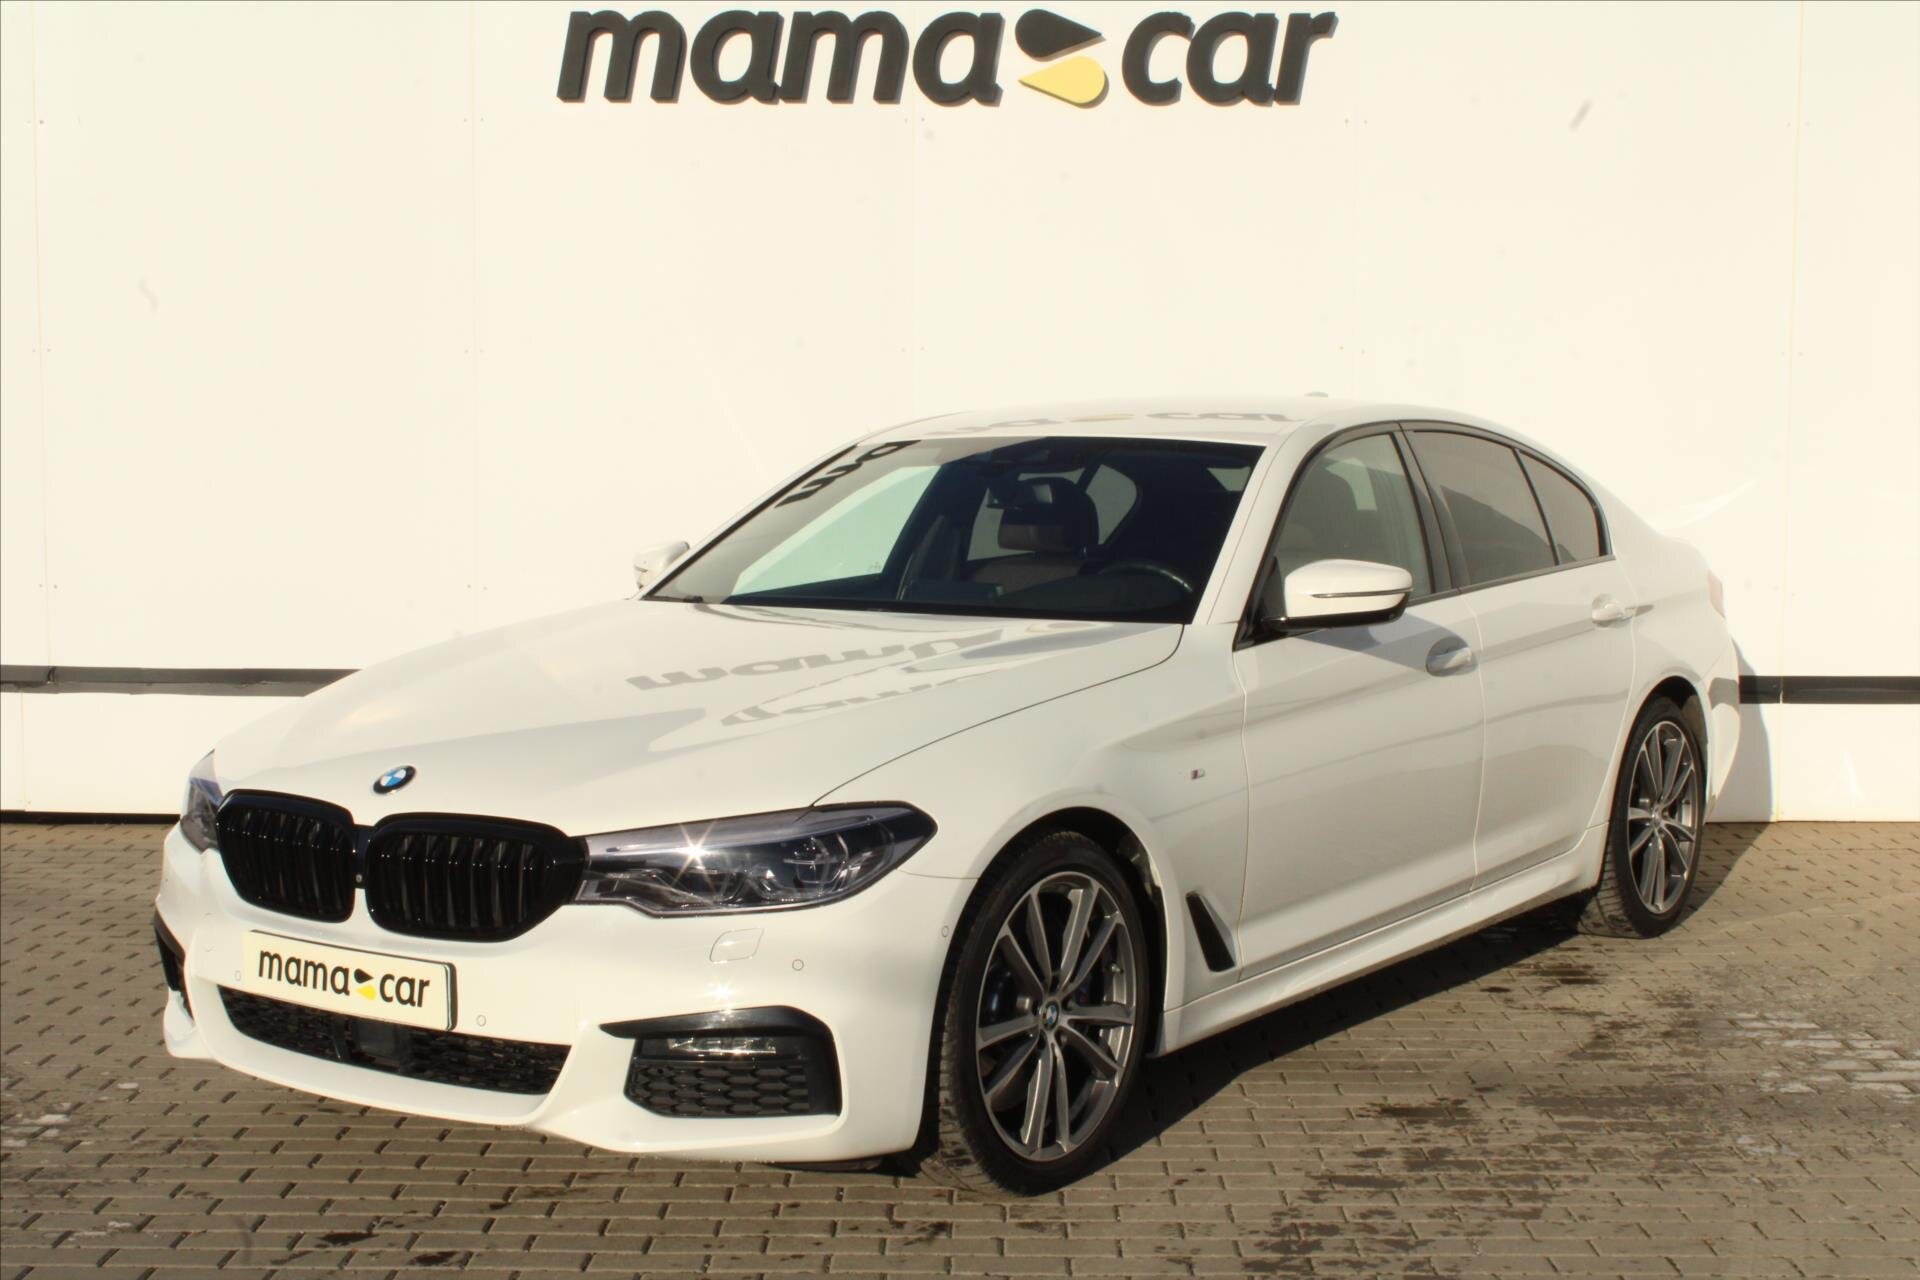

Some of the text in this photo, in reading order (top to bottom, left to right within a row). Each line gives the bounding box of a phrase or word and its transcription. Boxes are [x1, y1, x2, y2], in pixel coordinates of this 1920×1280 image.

[557, 10, 1338, 105] mama car
[258, 950, 430, 1008] mama car
